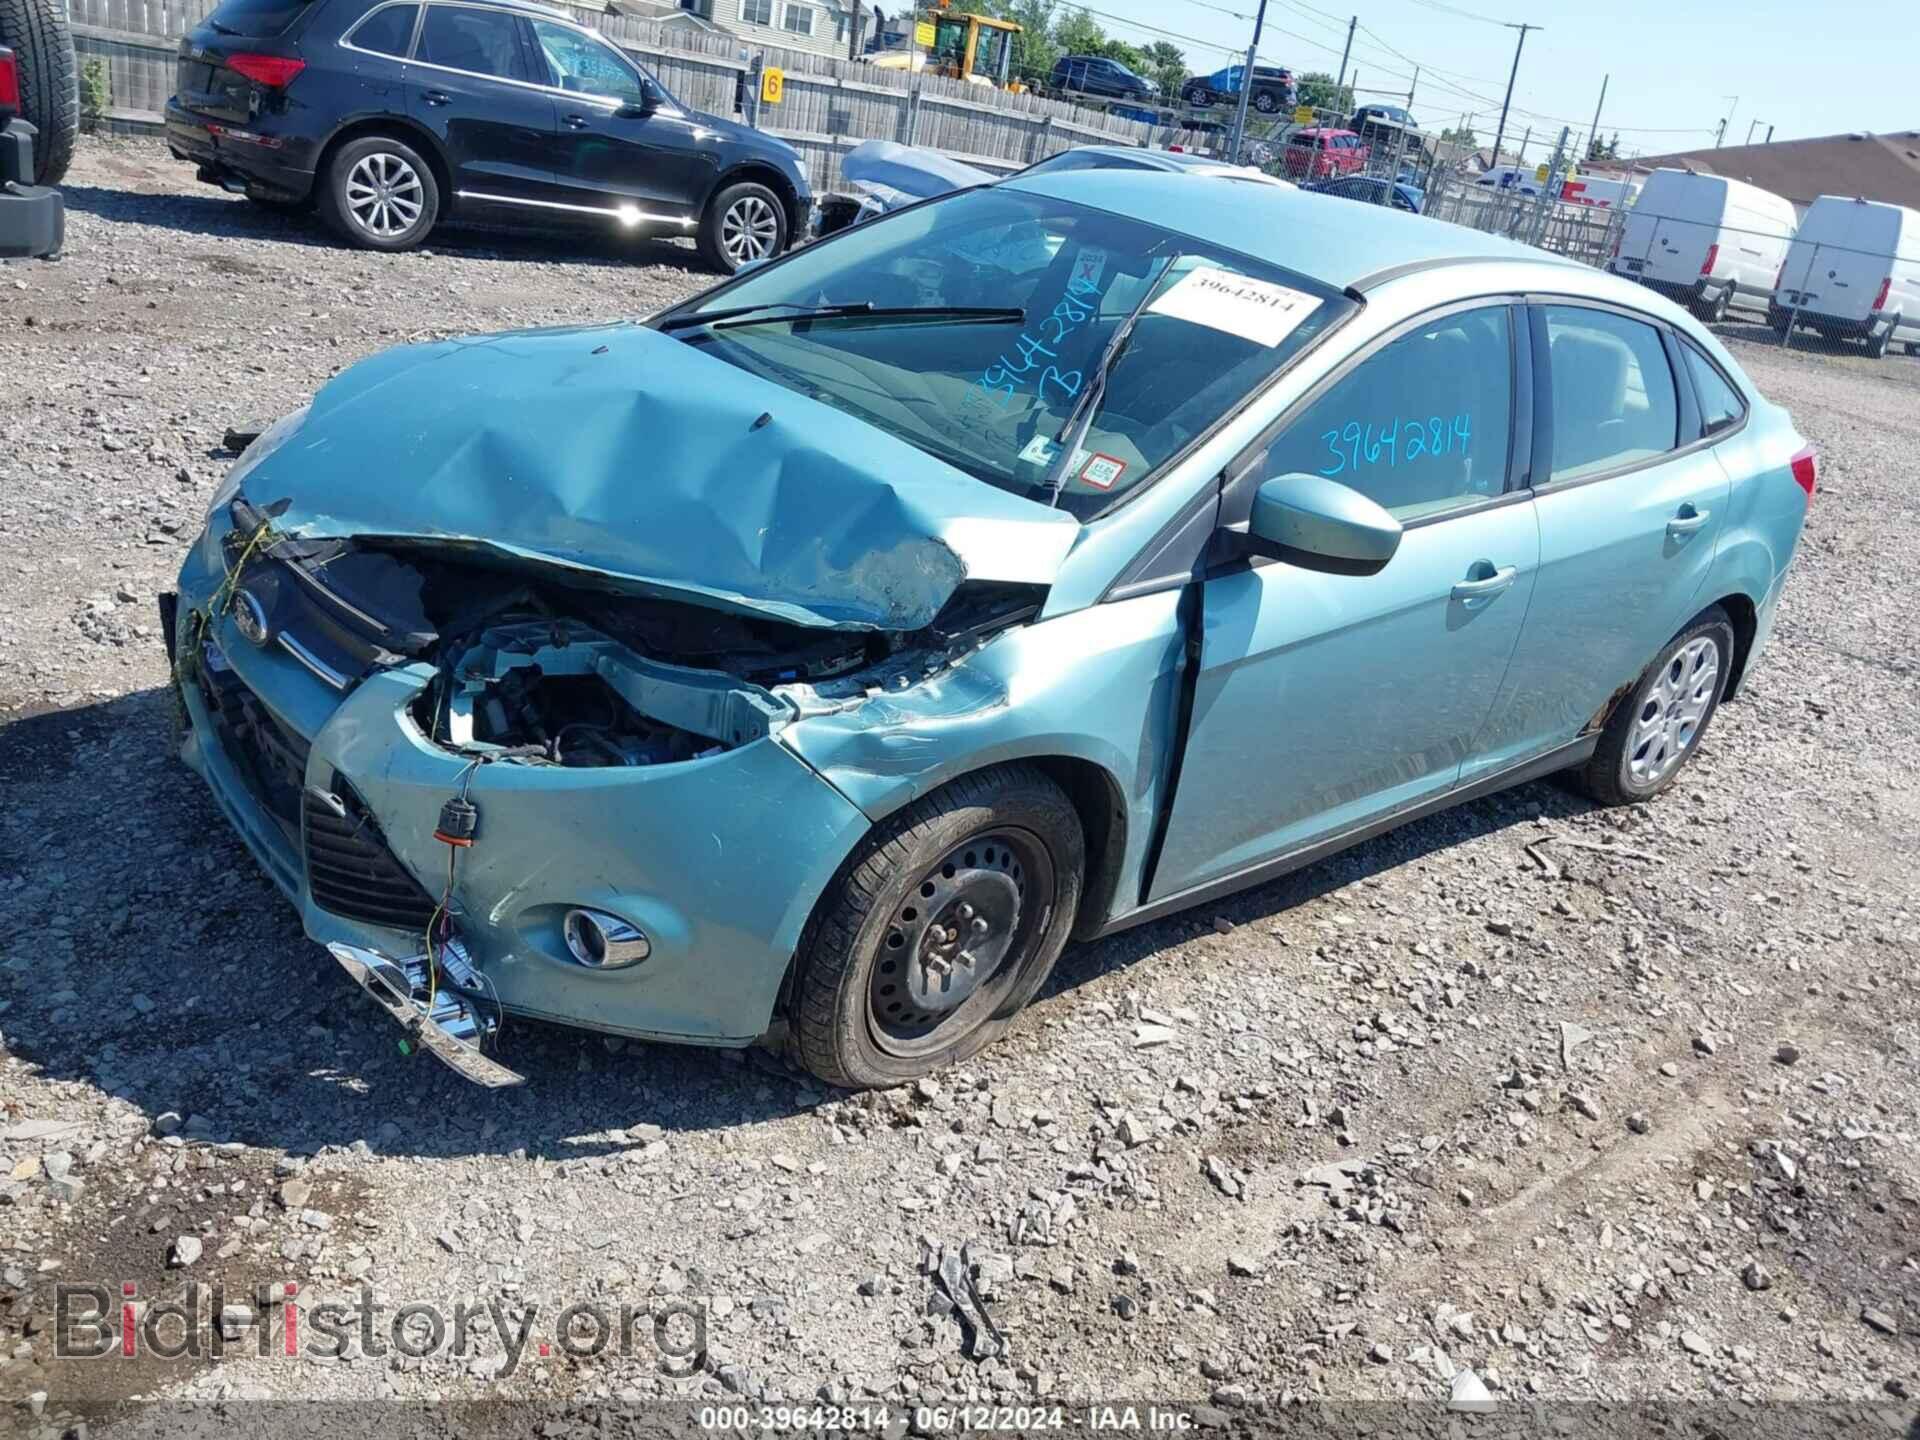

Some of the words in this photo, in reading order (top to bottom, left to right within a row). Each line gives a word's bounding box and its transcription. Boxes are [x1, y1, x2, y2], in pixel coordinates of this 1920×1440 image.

[768, 74, 778, 95] 6
[1199, 277, 1297, 312] 39642814
[1319, 414, 1471, 475] 39642814
